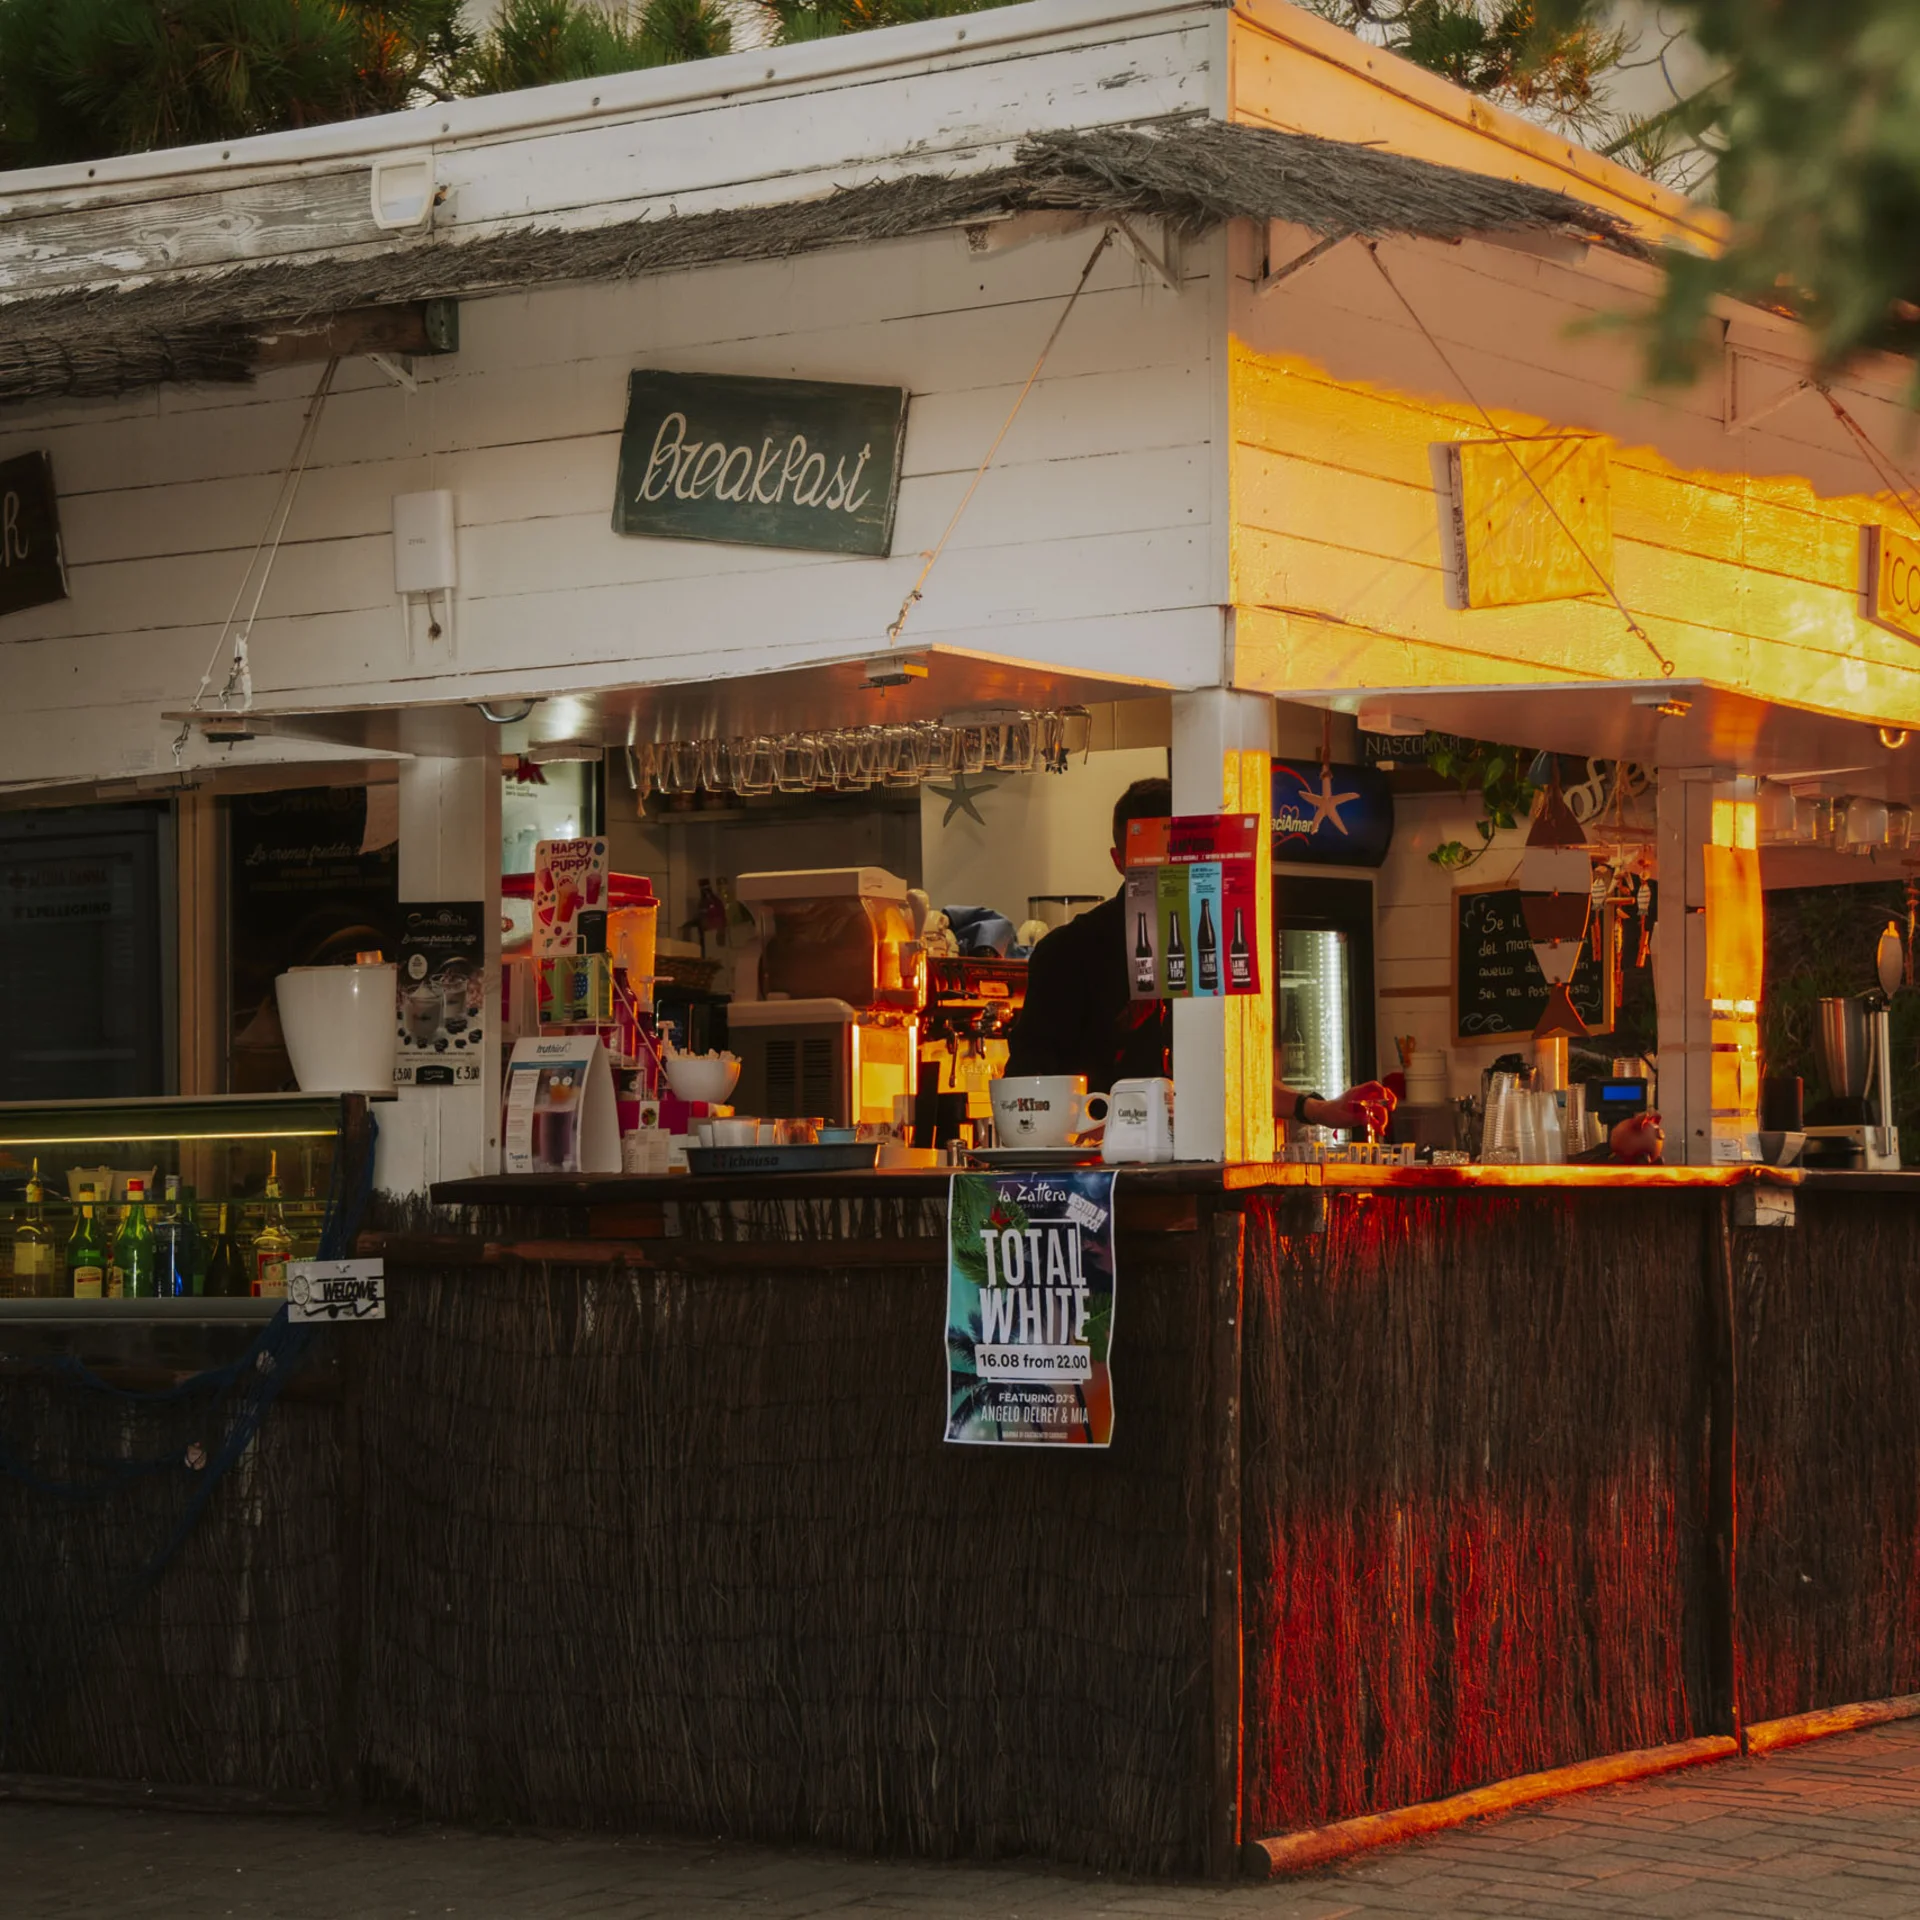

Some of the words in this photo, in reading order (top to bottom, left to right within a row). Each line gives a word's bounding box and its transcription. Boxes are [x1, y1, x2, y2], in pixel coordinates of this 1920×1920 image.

[635, 412, 871, 513] Breakfast
[551, 841, 592, 858] HAPPY
[551, 857, 592, 872] PUPPY
[1016, 1182, 1067, 1203] Zattera
[980, 1228, 1087, 1286] TOTAL
[323, 1280, 378, 1301] WELCOME
[979, 1288, 1091, 1345] WHITE
[979, 1353, 1020, 1368] 16.08
[1023, 1354, 1055, 1369] from
[1056, 1355, 1088, 1369] 22.00
[999, 1393, 1054, 1404] FEATURING
[1056, 1393, 1075, 1403] DJ'S
[981, 1405, 1020, 1423] ANGELO
[1023, 1406, 1059, 1423] DELREY
[1061, 1407, 1068, 1424] &
[1070, 1407, 1089, 1424] MIA
